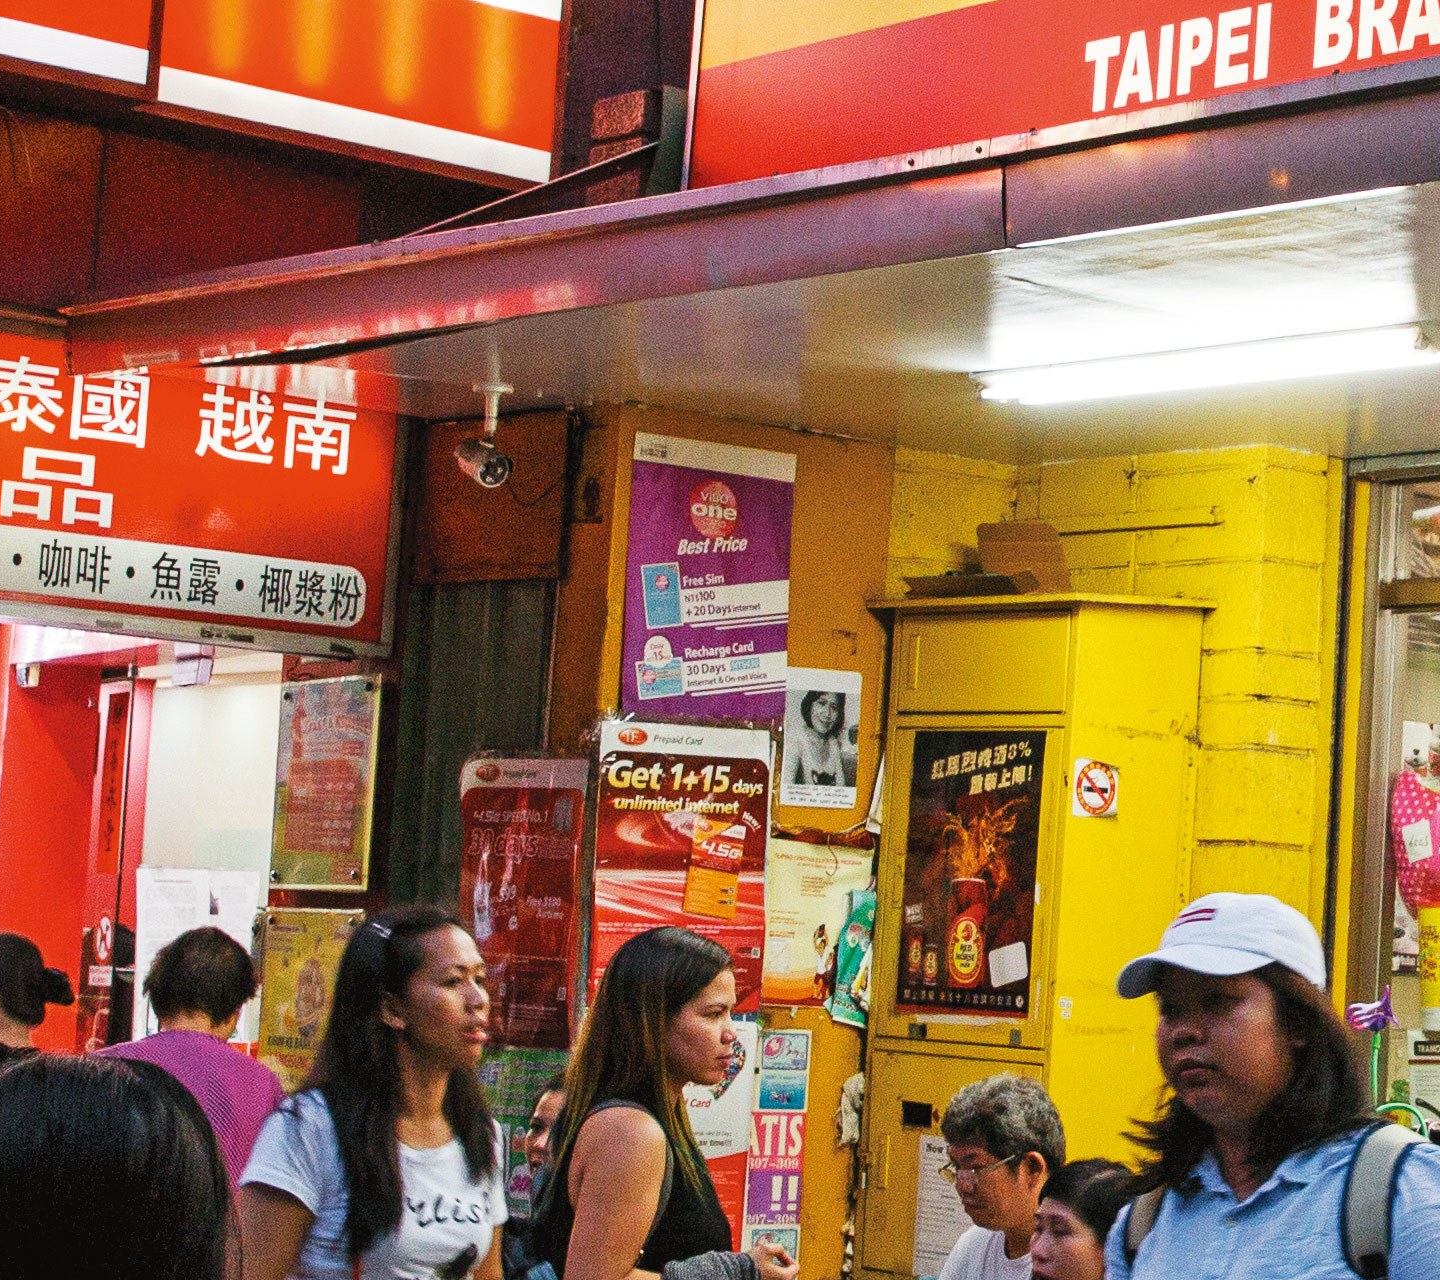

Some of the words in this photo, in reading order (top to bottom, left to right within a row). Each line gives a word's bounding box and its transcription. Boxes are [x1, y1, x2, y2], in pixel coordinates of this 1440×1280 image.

[1084, 3, 1272, 113] TAIPEI
[194, 384, 357, 475] 越南
[677, 537, 710, 556] Best
[713, 536, 748, 553] Price
[682, 574, 701, 587] Free
[702, 573, 725, 585] Sim
[684, 644, 731, 660] Recharge
[733, 641, 755, 653] Card
[653, 734, 683, 745] Prepaid
[685, 736, 703, 745] Card
[608, 760, 663, 789] Get
[670, 763, 731, 792] 1+15
[732, 779, 763, 798] days
[614, 796, 683, 812] unlimited
[685, 800, 740, 815] internet
